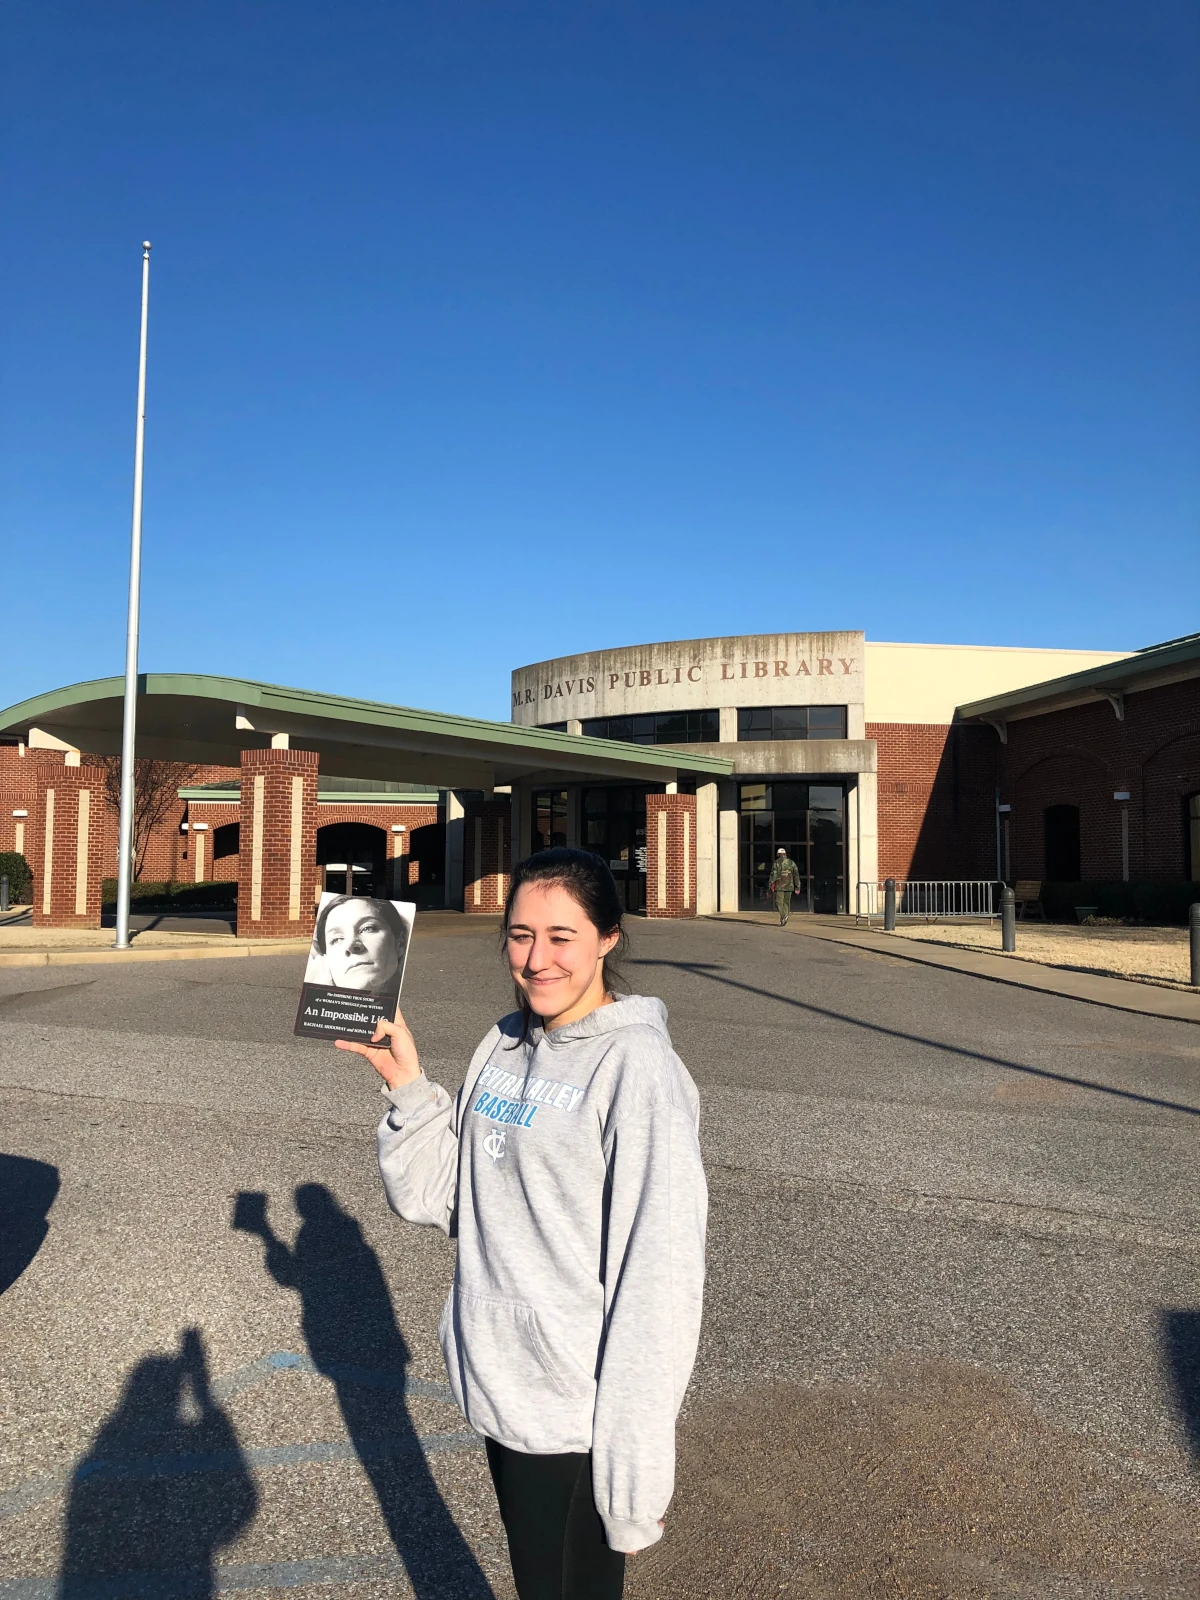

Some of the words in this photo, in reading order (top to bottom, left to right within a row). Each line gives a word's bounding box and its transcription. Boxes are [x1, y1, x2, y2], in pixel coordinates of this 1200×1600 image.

[512, 688, 535, 707] M.R.
[544, 676, 595, 700] DAVIS
[609, 665, 703, 691] PUBLIC
[721, 657, 857, 681] LIBRARY
[304, 1006, 319, 1016] An
[320, 1008, 369, 1023] Impossible
[473, 1091, 538, 1128] BASEBALL
[524, 1077, 585, 1112] VALLEY
